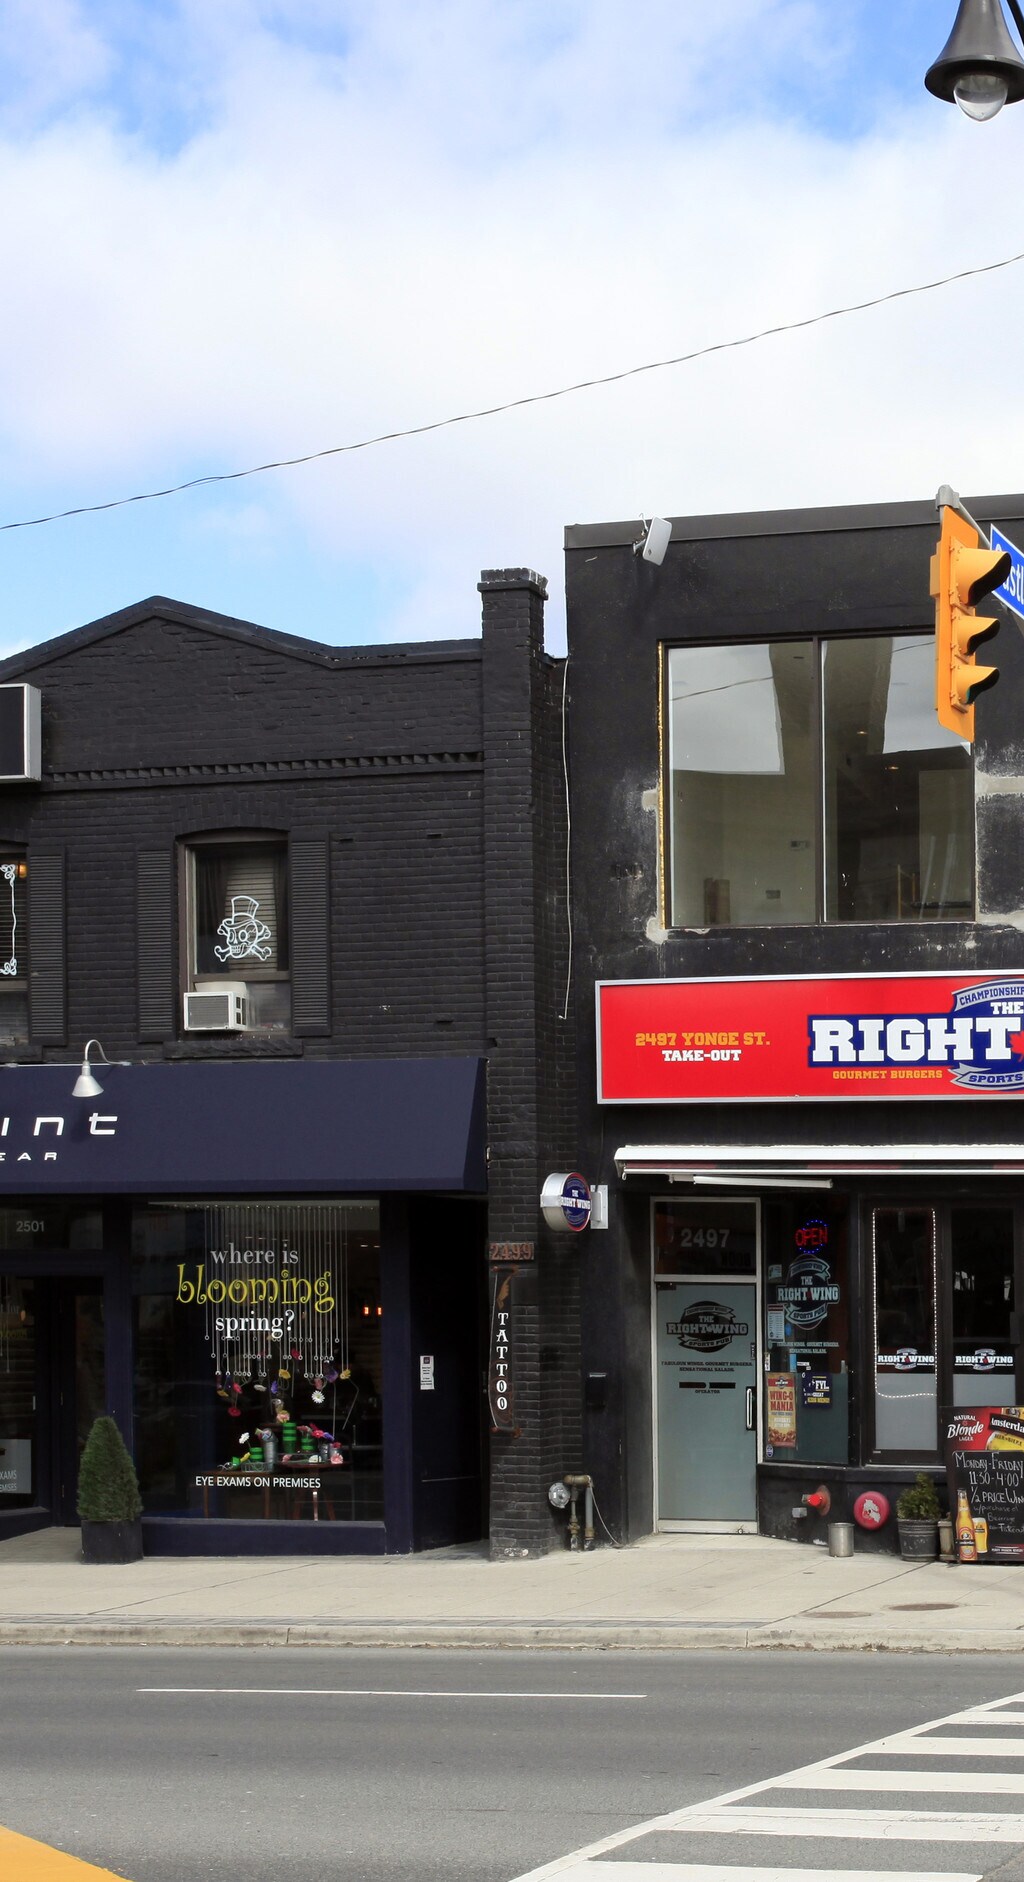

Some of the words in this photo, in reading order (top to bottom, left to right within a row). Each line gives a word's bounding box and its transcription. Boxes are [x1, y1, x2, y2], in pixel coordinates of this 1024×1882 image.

[990, 1002, 1024, 1014] THE
[635, 1032, 678, 1046] 2497
[682, 1032, 739, 1046] YONGE
[744, 1031, 771, 1046] ST.
[811, 1017, 1021, 1063] RIGHT
[662, 1049, 742, 1062] TAKE-OUT
[832, 1070, 887, 1080] GOURMET
[890, 1069, 943, 1079] BURGERS
[968, 1069, 1023, 1084] SPORTS
[16, 1220, 45, 1233] 2501
[680, 1228, 730, 1248] 2497
[794, 1227, 828, 1247] OPEN
[210, 1242, 275, 1264] where
[282, 1243, 299, 1264] is
[490, 1243, 533, 1260] 2499
[801, 1275, 813, 1285] THE
[176, 1263, 335, 1313] blooming
[777, 1287, 808, 1300] RIGHT
[811, 1287, 839, 1300] WING
[215, 1309, 295, 1339] spring?
[699, 1315, 714, 1323] THE
[667, 1323, 706, 1334] RIGHT
[711, 1323, 748, 1334] WING
[716, 1337, 730, 1345] PUB
[496, 1312, 509, 1410] TATTOO
[877, 1355, 906, 1363] RIGHT
[908, 1355, 935, 1363] WING
[955, 1355, 983, 1363] RIGHT
[985, 1356, 1013, 1364] WING
[770, 1401, 794, 1412] MANIA
[947, 1421, 984, 1439] Blonde
[195, 1476, 214, 1487] EYE
[217, 1477, 251, 1487] EXAMS
[254, 1477, 270, 1487] ON
[273, 1477, 321, 1488] PREMISES
[982, 1491, 1006, 1503] PRICE
